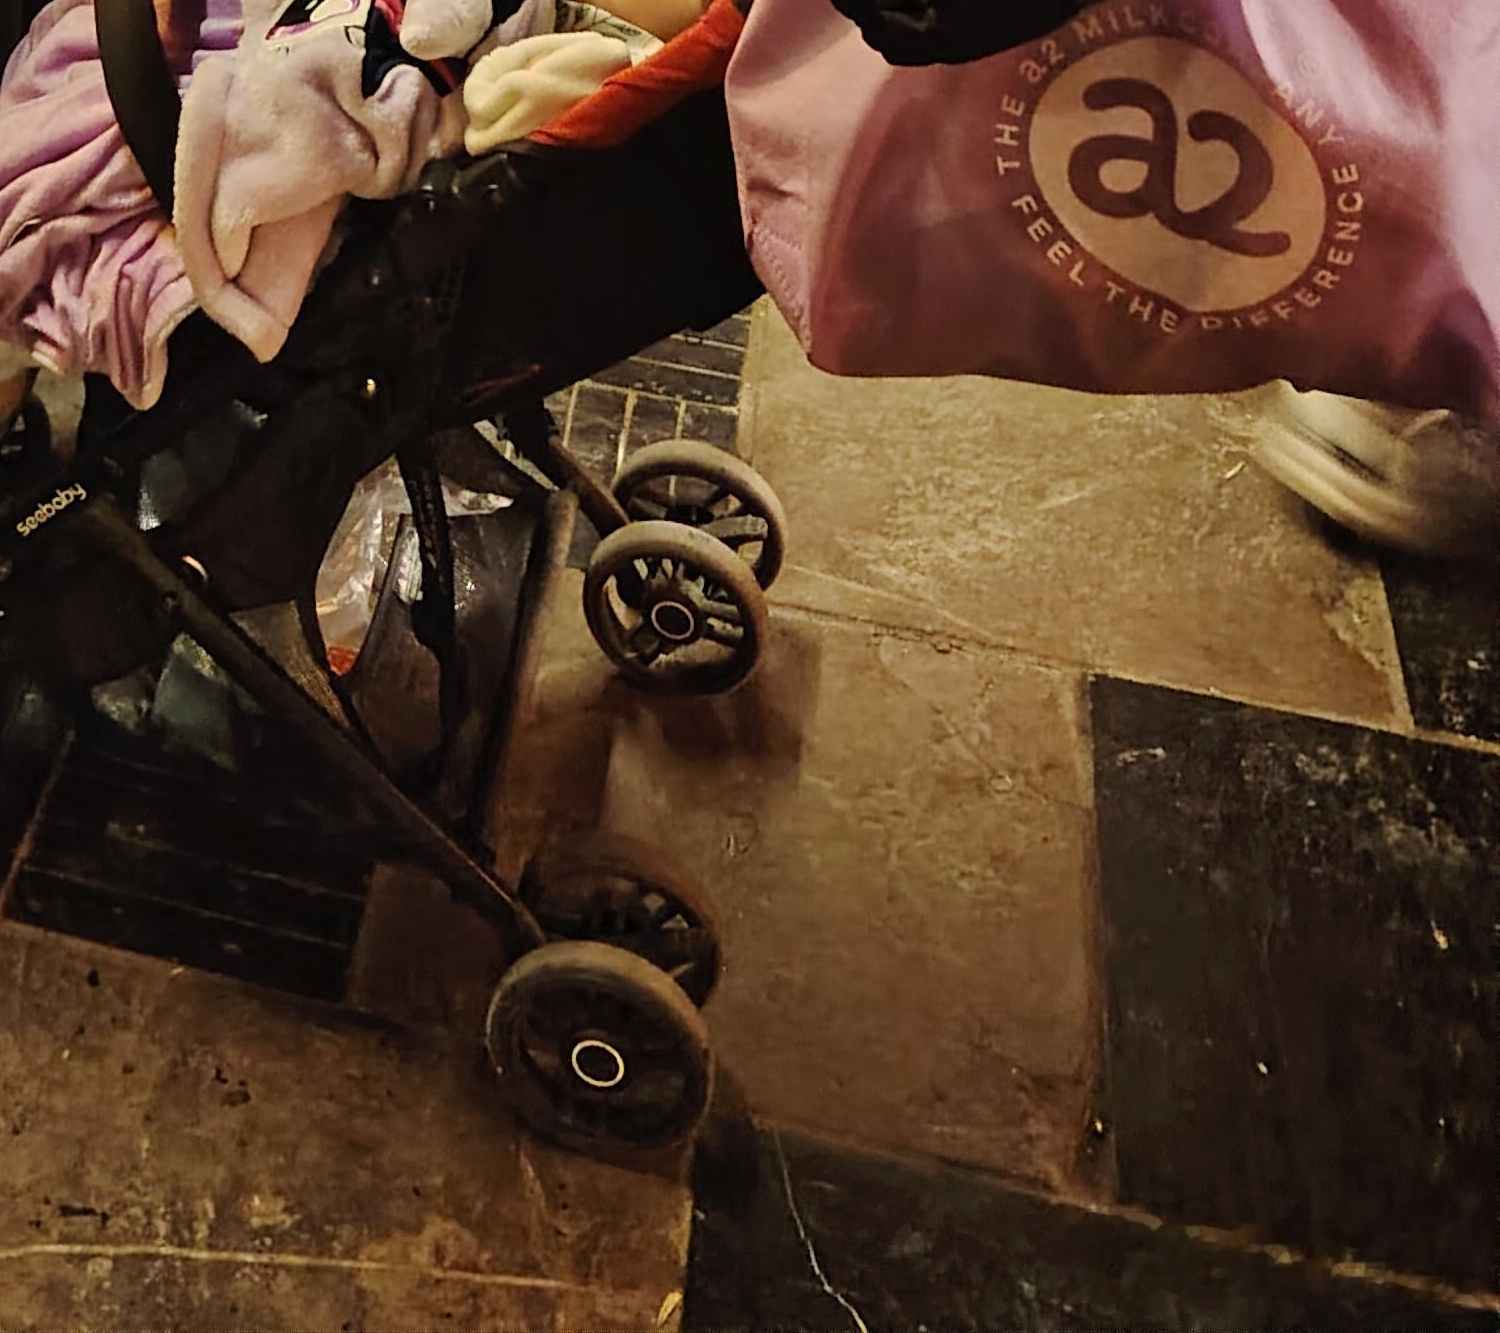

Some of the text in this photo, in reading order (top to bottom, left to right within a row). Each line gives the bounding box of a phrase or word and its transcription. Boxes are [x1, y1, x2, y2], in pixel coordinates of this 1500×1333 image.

[996, 94, 1026, 176] THE
[1019, 39, 1066, 82] a2
[1071, 4, 1168, 44] MILK
[1011, 163, 1364, 334] FEEL THE DIFFERENCE
[16, 483, 87, 537] seebaby
